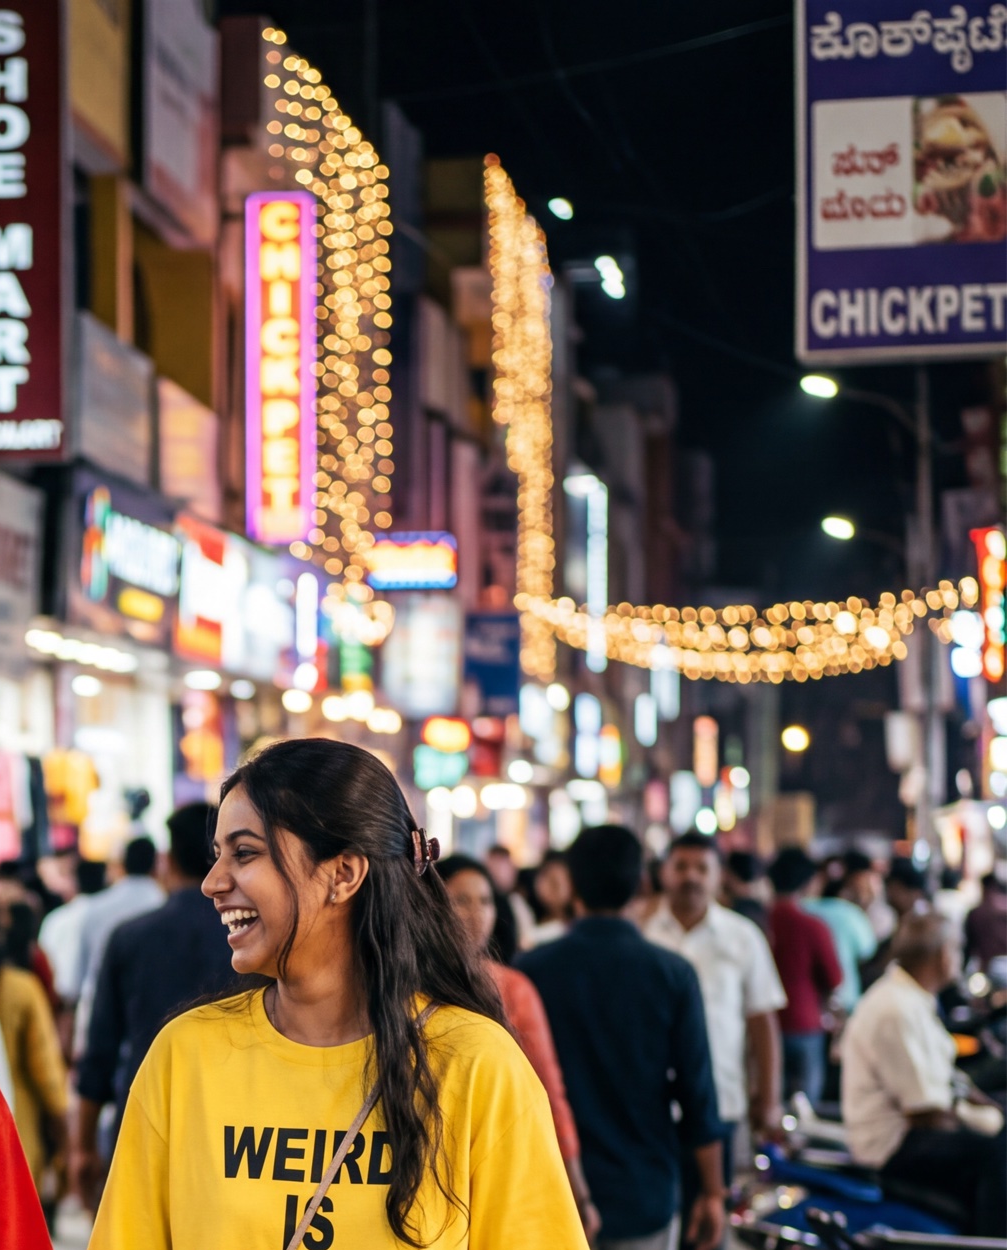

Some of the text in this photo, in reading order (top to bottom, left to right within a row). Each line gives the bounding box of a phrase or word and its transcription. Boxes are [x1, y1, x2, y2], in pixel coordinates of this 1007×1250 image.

[811, 283, 1007, 338] CHICKPET
[258, 200, 301, 513] CHICKPET
[223, 1125, 394, 1185] WEIRD
